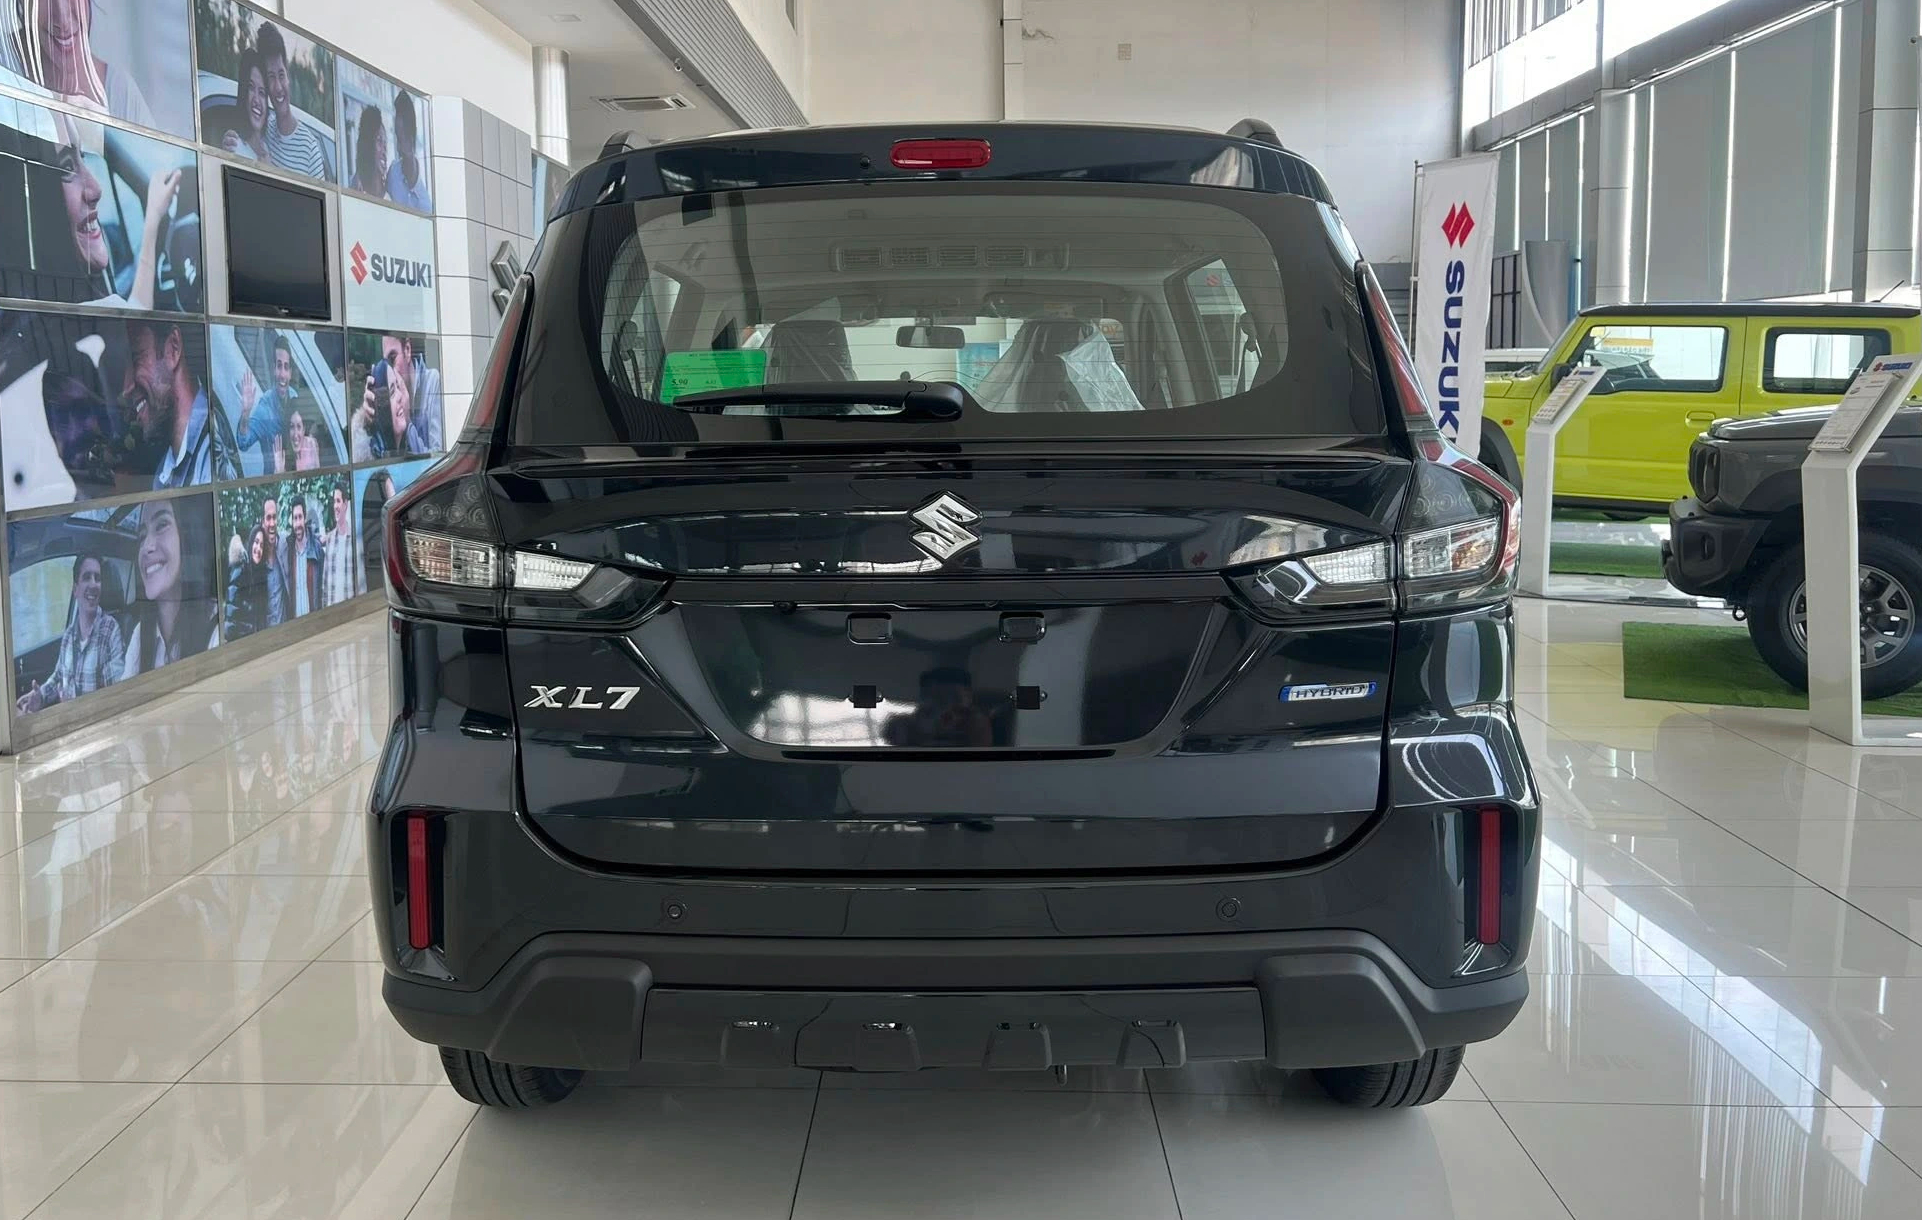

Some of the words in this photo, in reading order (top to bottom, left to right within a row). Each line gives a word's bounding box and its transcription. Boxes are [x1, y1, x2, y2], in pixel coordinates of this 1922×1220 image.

[371, 253, 432, 288] SUZUKI
[524, 685, 641, 709] XL7
[1296, 684, 1365, 698] HYBRID
